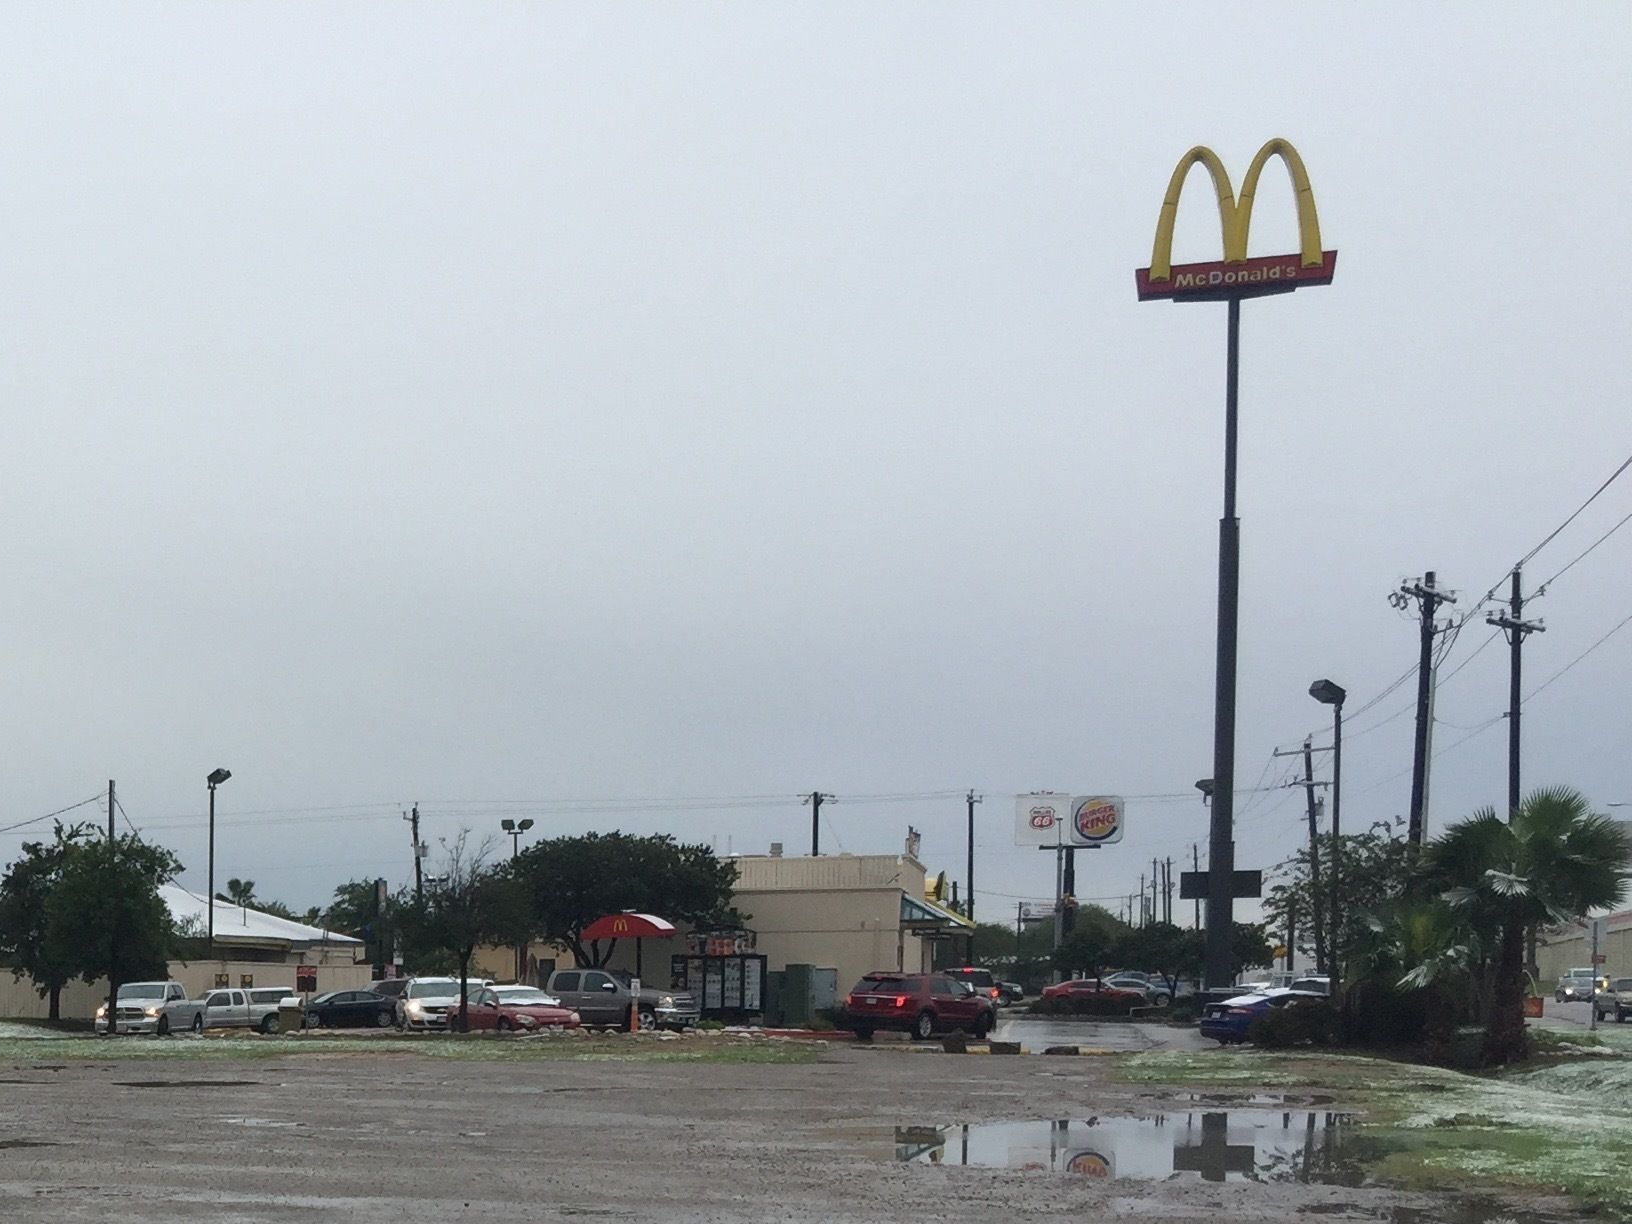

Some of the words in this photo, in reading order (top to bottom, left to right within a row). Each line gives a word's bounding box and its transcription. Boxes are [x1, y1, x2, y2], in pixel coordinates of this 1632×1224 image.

[1174, 265, 1296, 289] McDonald's
[1034, 816, 1050, 825] 66
[1079, 805, 1115, 820] BURGER
[1080, 813, 1116, 832] KING
